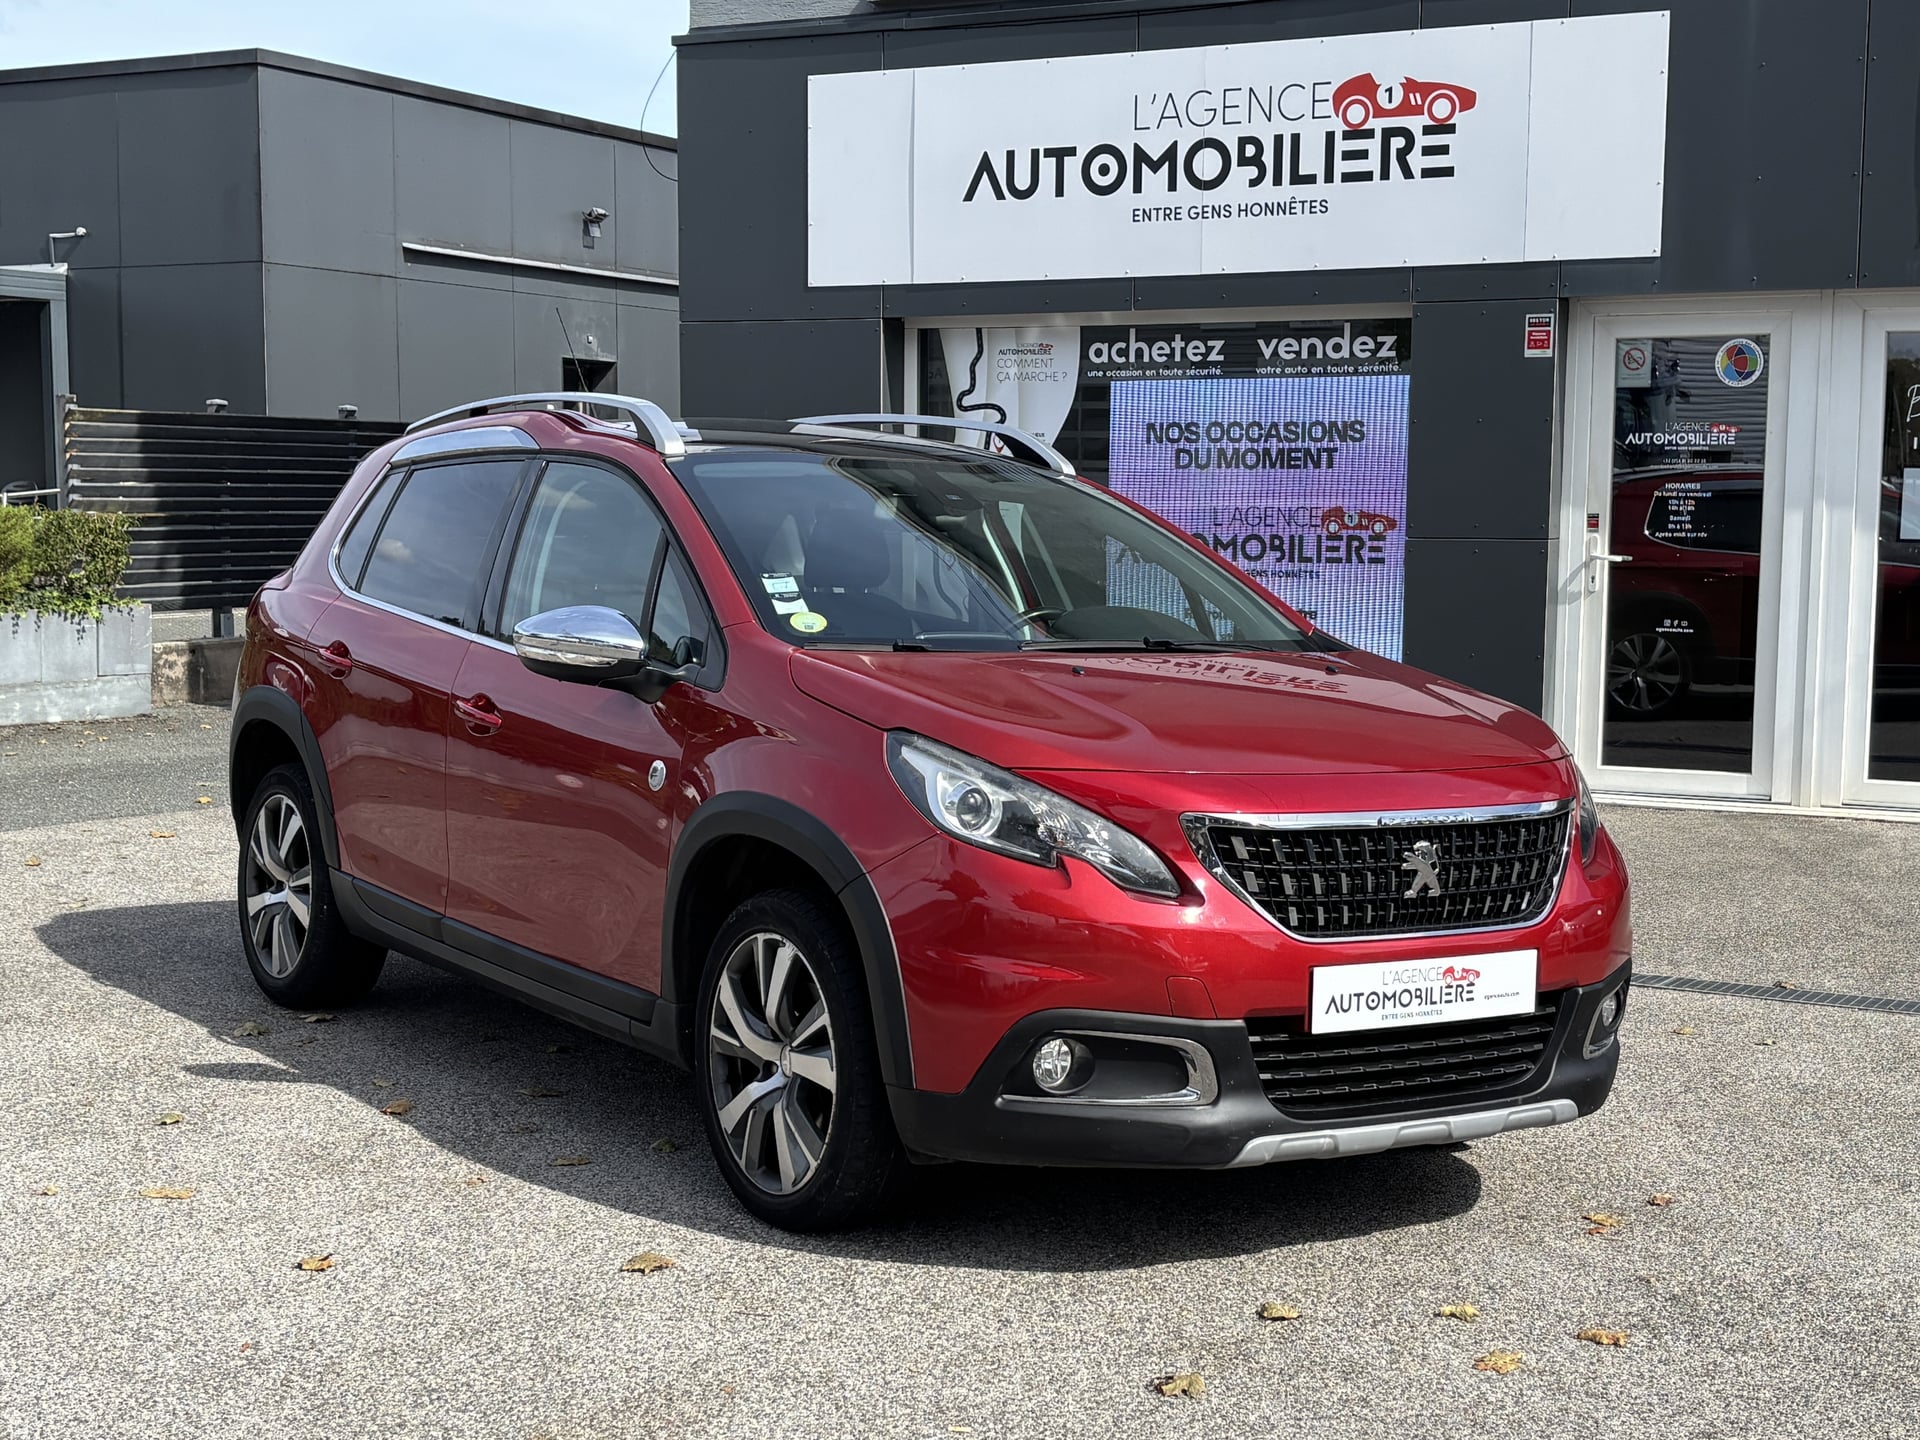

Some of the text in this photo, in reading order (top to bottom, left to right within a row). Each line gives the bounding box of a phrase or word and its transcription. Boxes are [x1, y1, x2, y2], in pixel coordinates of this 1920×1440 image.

[1383, 85, 1394, 105] 1
[1131, 195, 1329, 223] ENTRE GENS HONNÊTES
[1088, 327, 1226, 364] achetez
[1256, 322, 1398, 361] vendez
[996, 358, 1055, 369] COMMENT
[1105, 366, 1143, 377] occasion
[1145, 369, 1157, 377] en
[1159, 367, 1183, 377] toute
[1185, 365, 1224, 376] sécurité.
[1255, 365, 1282, 375] votre
[1284, 364, 1308, 374] auto
[1327, 364, 1354, 373] toute
[1357, 361, 1402, 373] sérénité.
[996, 371, 1068, 384] ÇA MARCHE ?
[1146, 419, 1366, 444] NOS OCCASIONS
[1174, 446, 1339, 471] DU MOMENT
[1191, 533, 1387, 565] MOBILIERE
